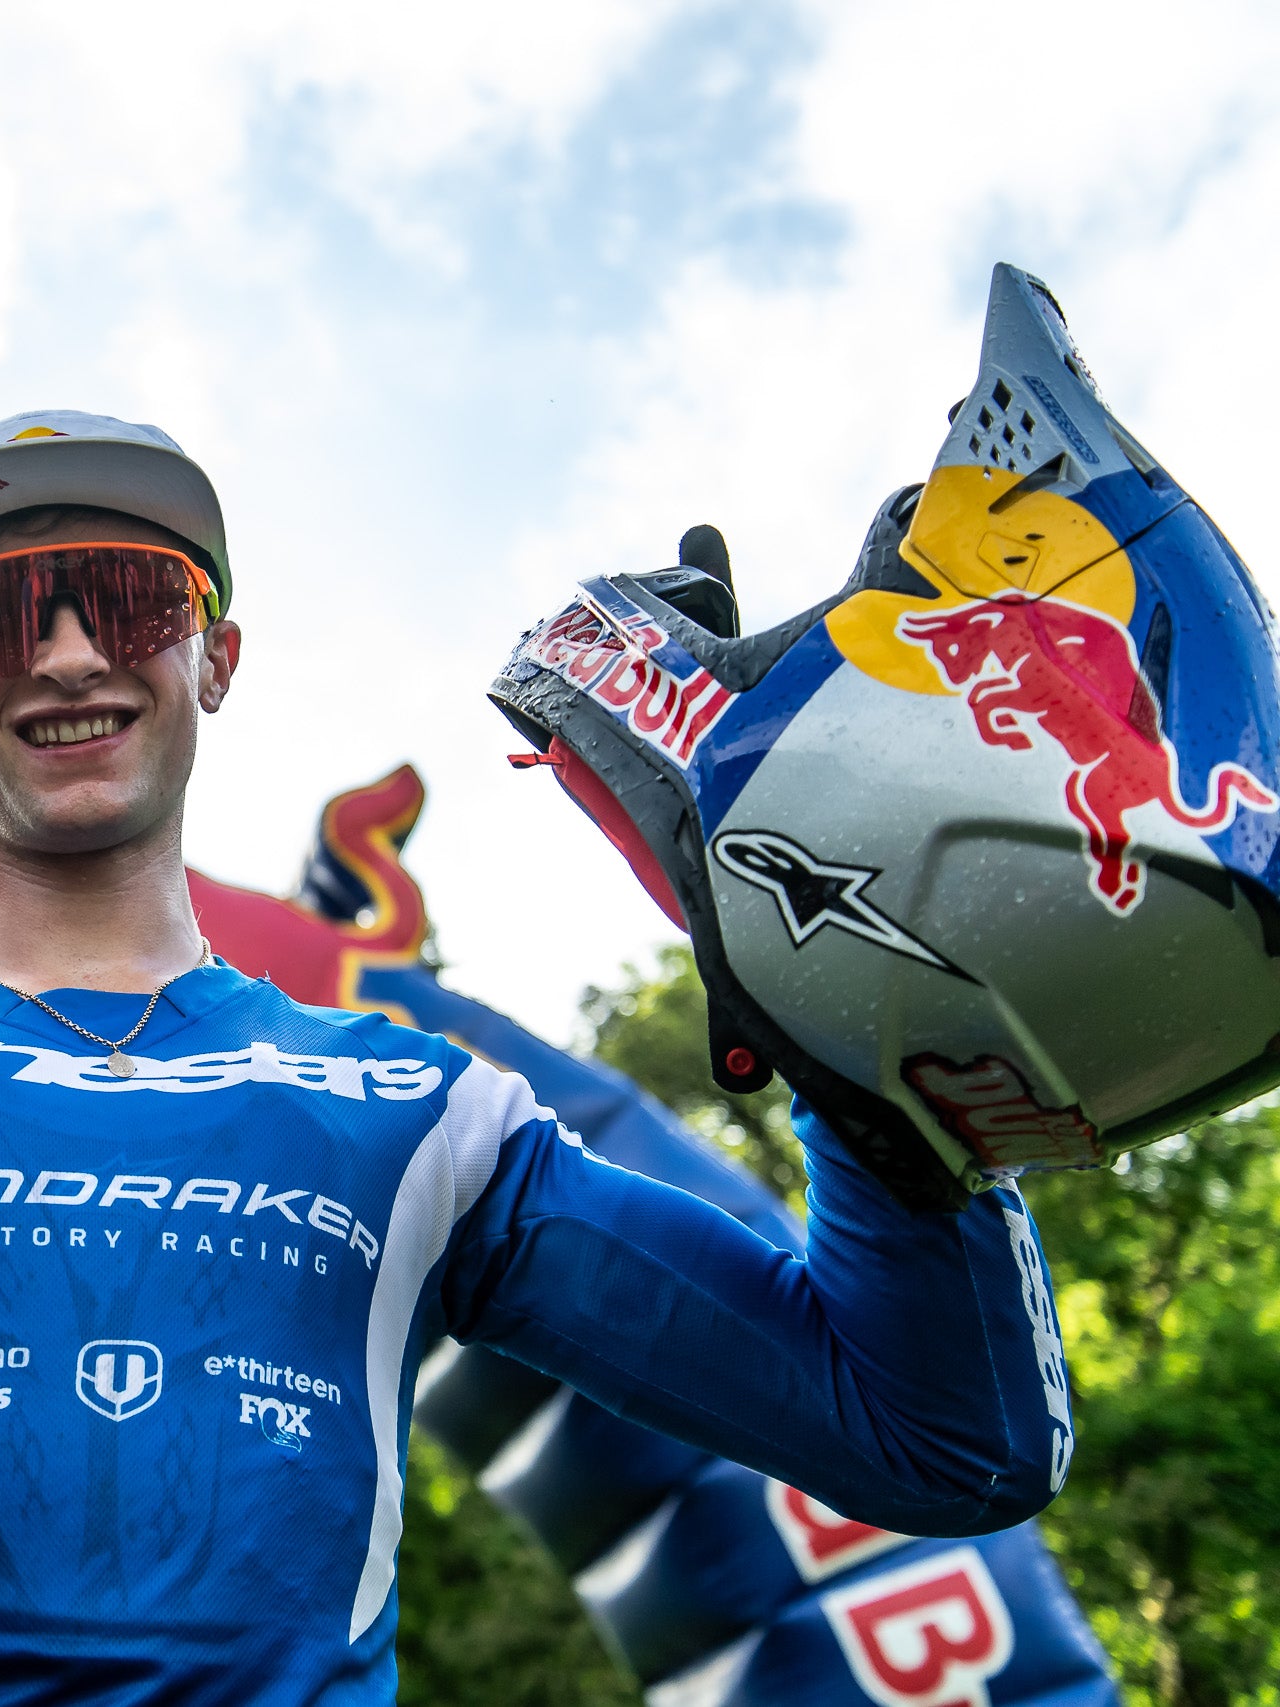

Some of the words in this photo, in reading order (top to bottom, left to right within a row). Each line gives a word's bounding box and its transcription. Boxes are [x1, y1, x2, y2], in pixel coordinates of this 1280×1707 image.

[595, 626, 733, 758] Bull
[162, 1231, 328, 1276] RACING
[996, 1178, 1075, 1497] nestars
[239, 1392, 312, 1448] FOX
